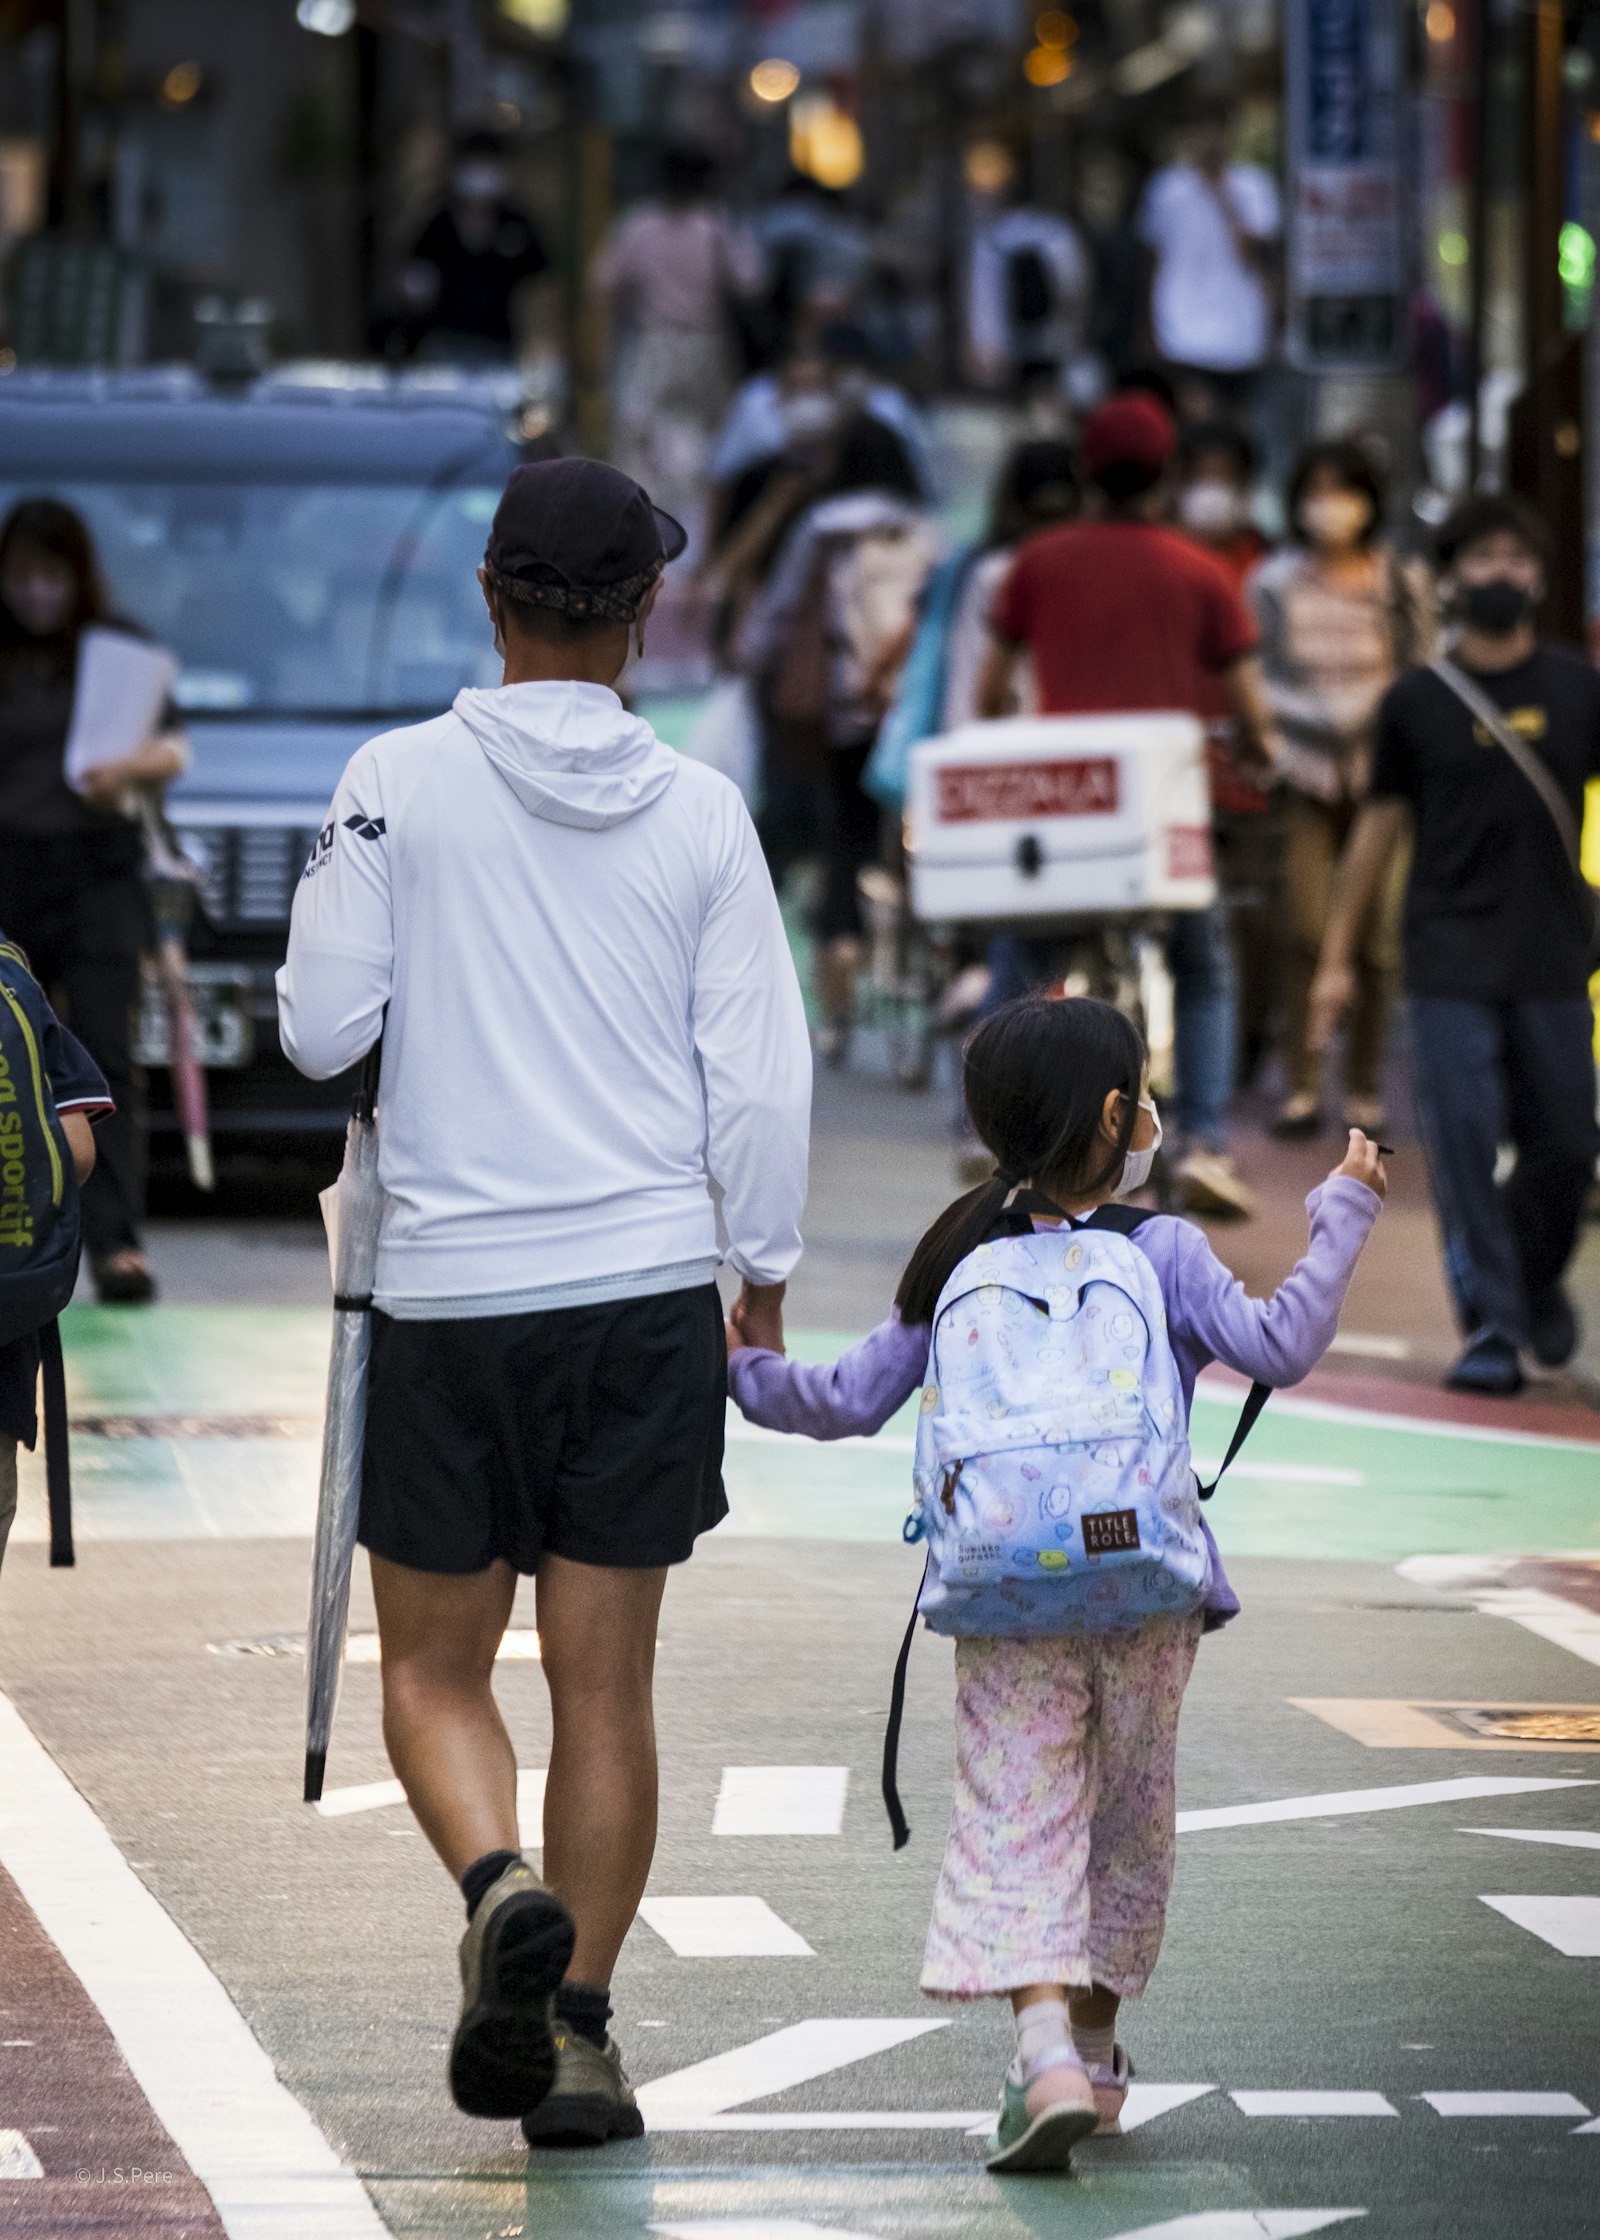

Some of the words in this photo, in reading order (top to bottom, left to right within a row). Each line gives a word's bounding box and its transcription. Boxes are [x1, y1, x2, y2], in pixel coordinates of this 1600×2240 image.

[0, 1110, 34, 1246] sportif
[1088, 1515, 1129, 1532] TITLE
[959, 1543, 1001, 1553] Sumikko
